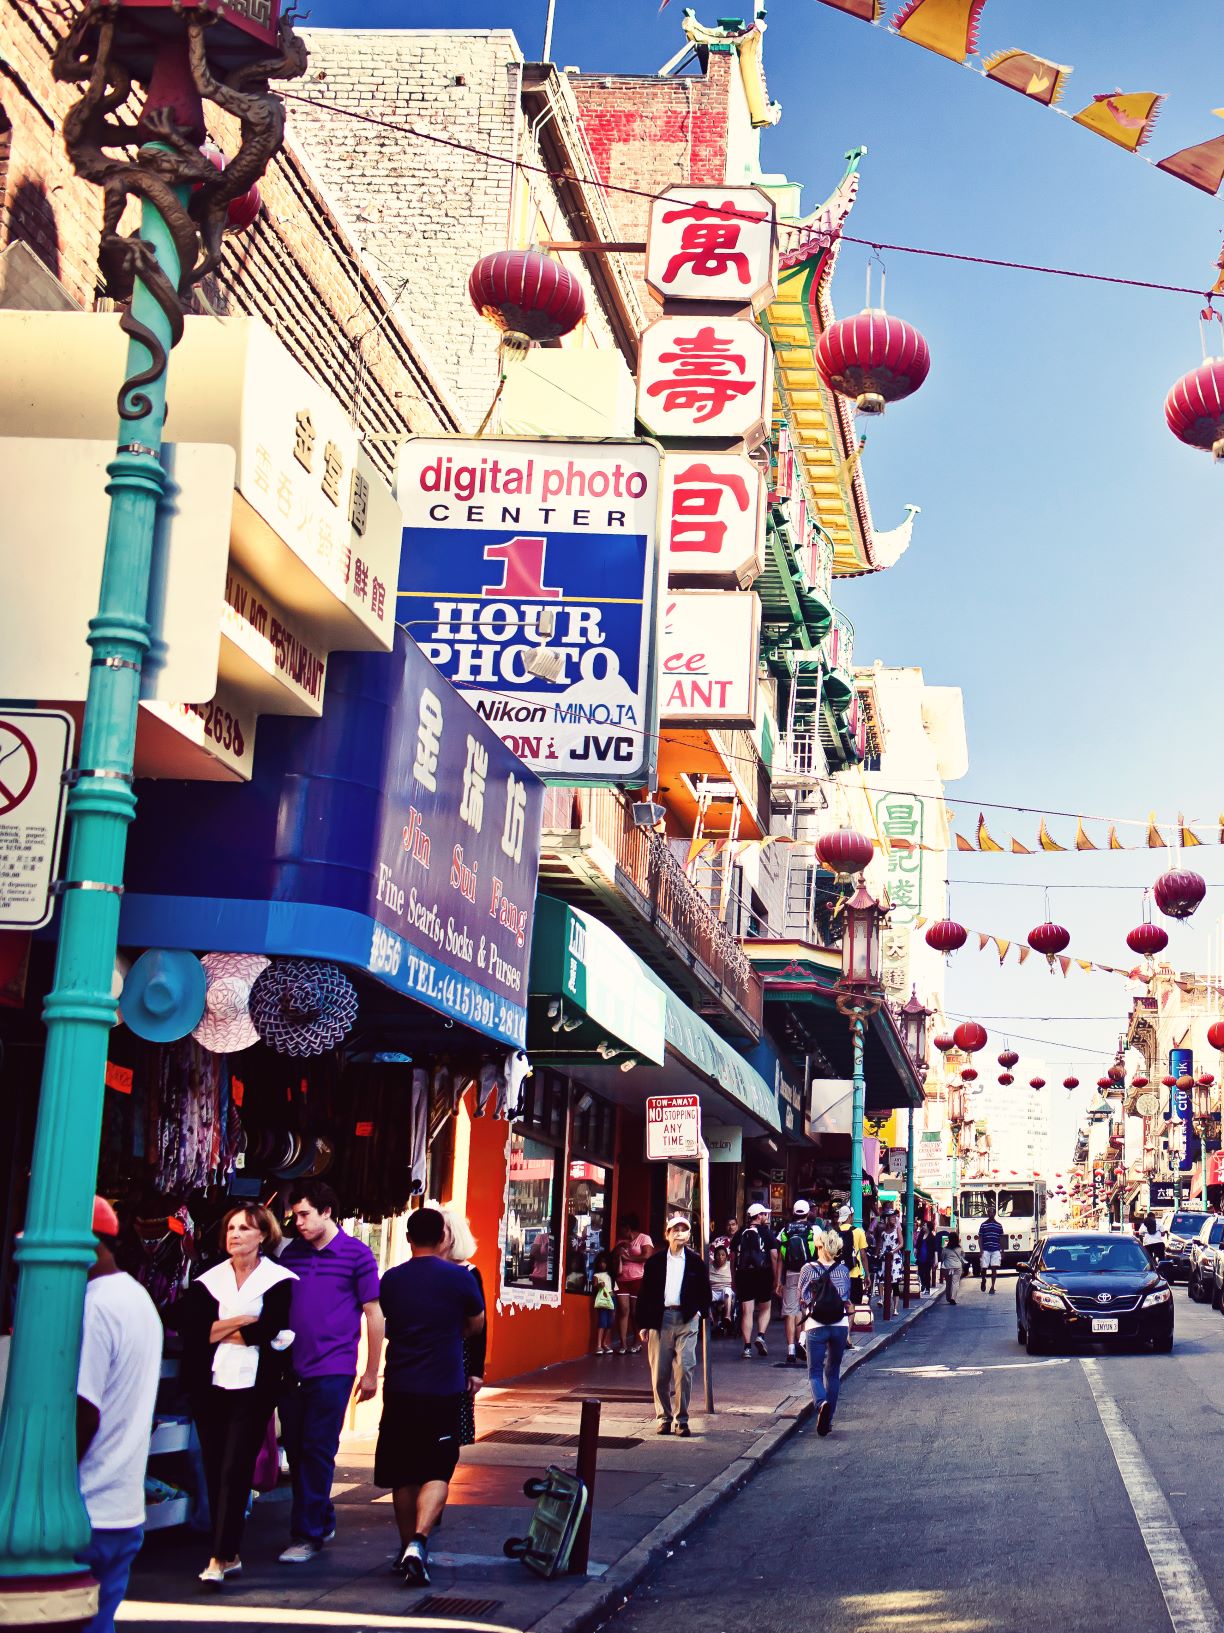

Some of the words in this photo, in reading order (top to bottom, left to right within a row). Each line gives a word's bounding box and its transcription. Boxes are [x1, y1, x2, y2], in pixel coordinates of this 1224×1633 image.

[420, 457, 533, 501] digital
[541, 461, 648, 502] photo
[429, 504, 626, 527] CENTER
[481, 536, 563, 600] 1
[431, 602, 606, 645] HOUR
[475, 700, 547, 723] Nikon
[569, 735, 634, 762] JVC
[402, 805, 431, 870] Jin
[451, 844, 478, 904] Sui
[489, 875, 527, 948] Fang
[376, 863, 404, 916] Fine
[445, 915, 474, 970] Socks
[477, 935, 487, 969] &
[488, 942, 522, 993] Purses
[369, 927, 400, 974] #956
[649, 1108, 662, 1121] NO
[664, 1110, 696, 1121] STOPPING
[652, 1098, 694, 1107] TOW-AWAY
[663, 1123, 683, 1134] ANY
[663, 1135, 684, 1146] TIME
